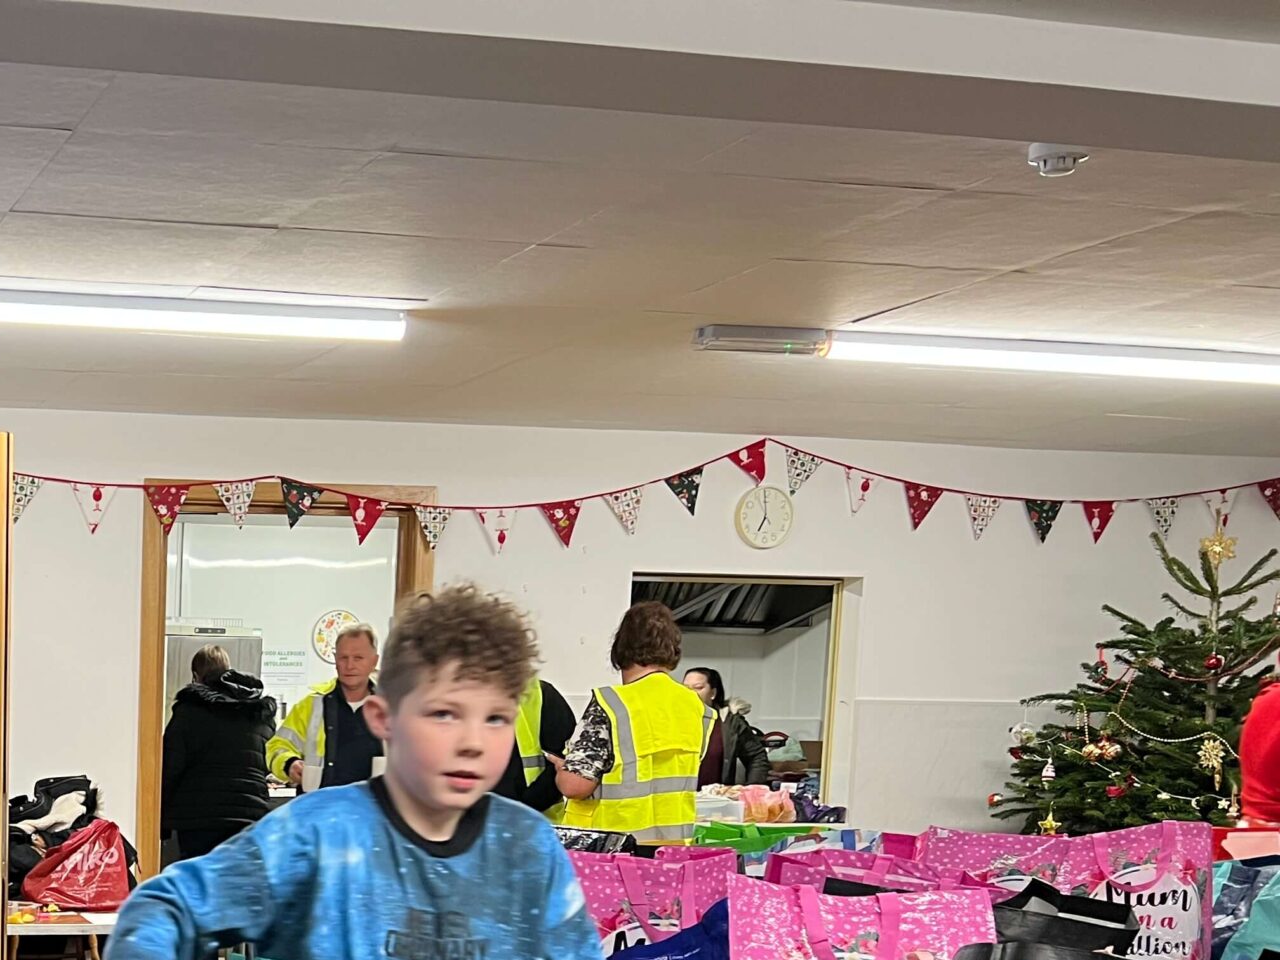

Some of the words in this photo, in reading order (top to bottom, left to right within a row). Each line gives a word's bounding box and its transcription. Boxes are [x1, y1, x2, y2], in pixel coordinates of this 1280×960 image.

[1106, 881, 1192, 912] Mum
[1138, 915, 1155, 930] n
[1160, 916, 1178, 930] a
[1126, 935, 1191, 956] illion
